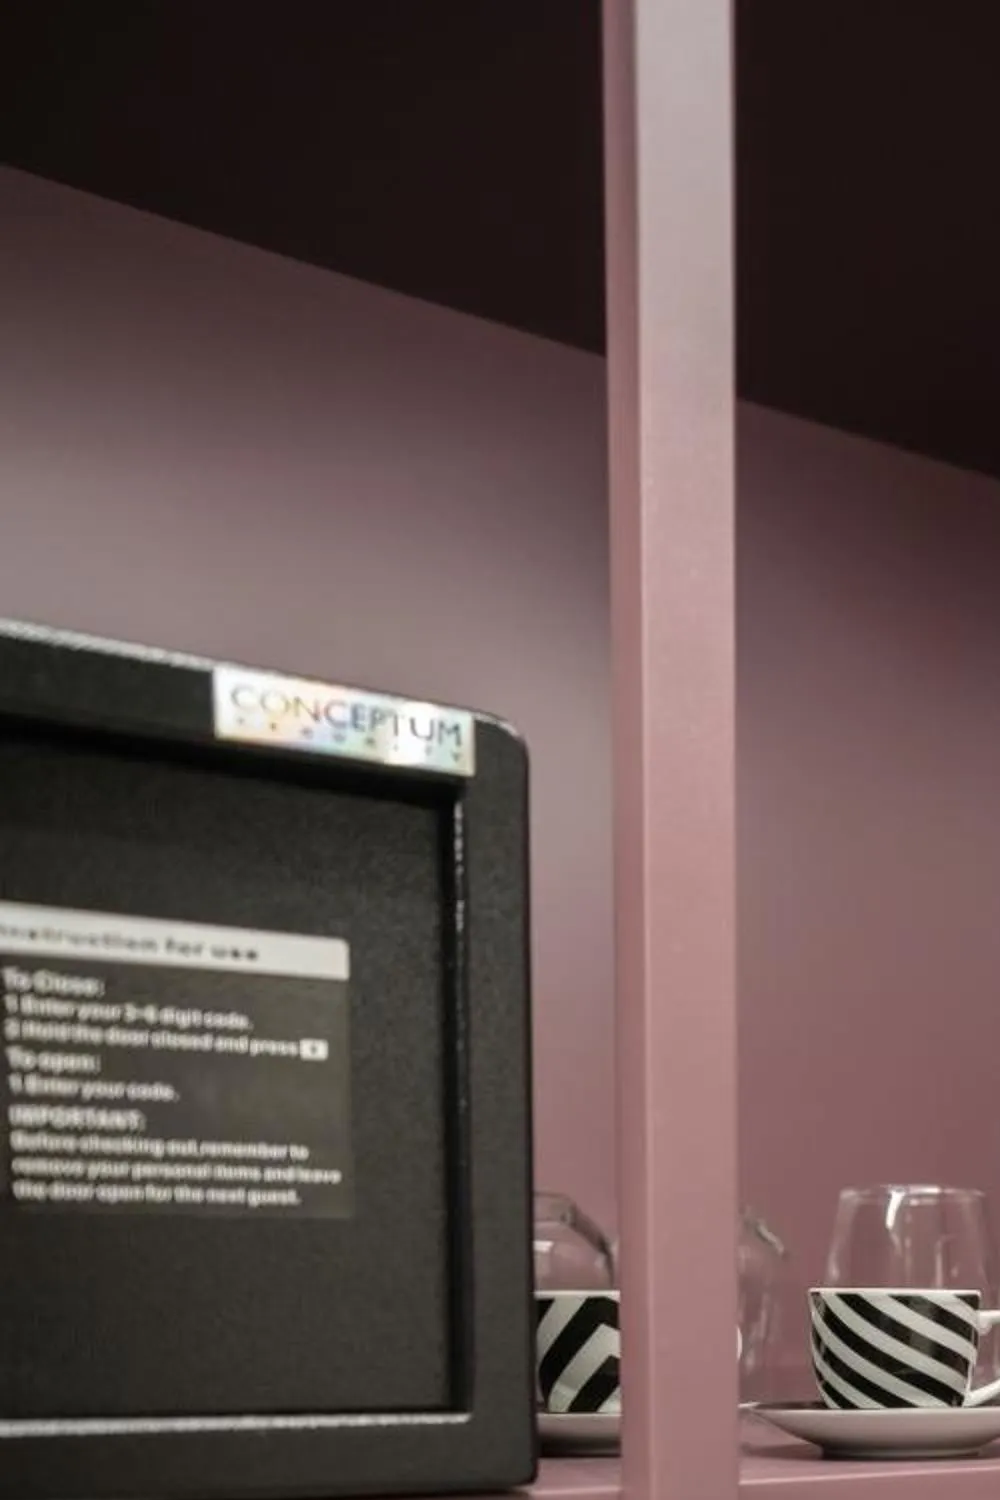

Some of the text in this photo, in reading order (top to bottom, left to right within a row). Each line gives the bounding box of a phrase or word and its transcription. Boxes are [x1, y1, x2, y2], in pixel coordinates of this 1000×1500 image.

[230, 684, 464, 748] CONCEPTUM
[3, 965, 32, 992] To
[20, 993, 76, 1018] Enter
[77, 1001, 122, 1024] your
[159, 1005, 202, 1030] digit
[104, 1025, 149, 1049] door
[150, 1028, 214, 1051] closed
[214, 1033, 249, 1053] and
[6, 1045, 36, 1070] To
[24, 1072, 80, 1099] Enter
[81, 1079, 125, 1102] your
[10, 1129, 78, 1153] Before
[79, 1133, 164, 1159] checking
[11, 1156, 85, 1177] remove
[86, 1159, 130, 1182] your
[131, 1161, 212, 1183] personal
[48, 1178, 95, 1203] door
